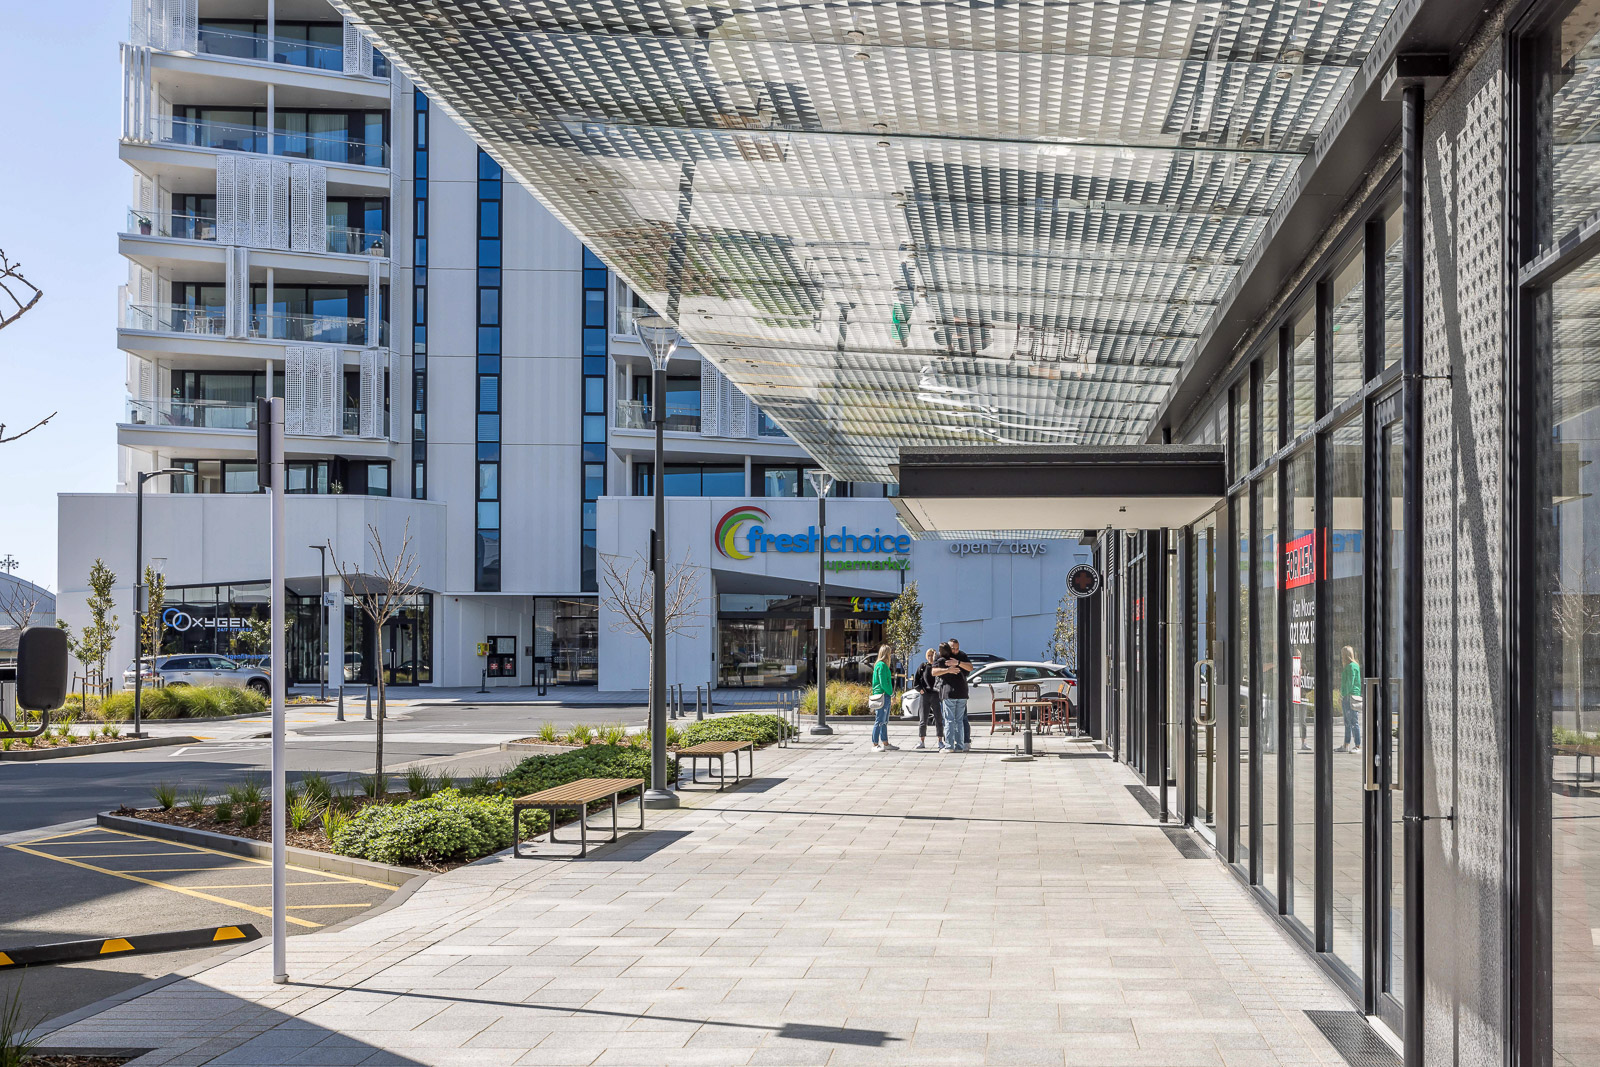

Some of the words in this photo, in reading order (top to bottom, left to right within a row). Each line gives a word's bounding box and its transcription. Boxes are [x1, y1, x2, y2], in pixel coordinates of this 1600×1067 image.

[949, 542, 991, 558] open
[996, 540, 1005, 554] 7
[1009, 540, 1047, 558] days
[1286, 549, 1299, 582] FOR
[1300, 544, 1314, 578] LEA
[863, 597, 892, 612] fres
[1289, 621, 1298, 645] 021
[1299, 620, 1310, 645] 882
